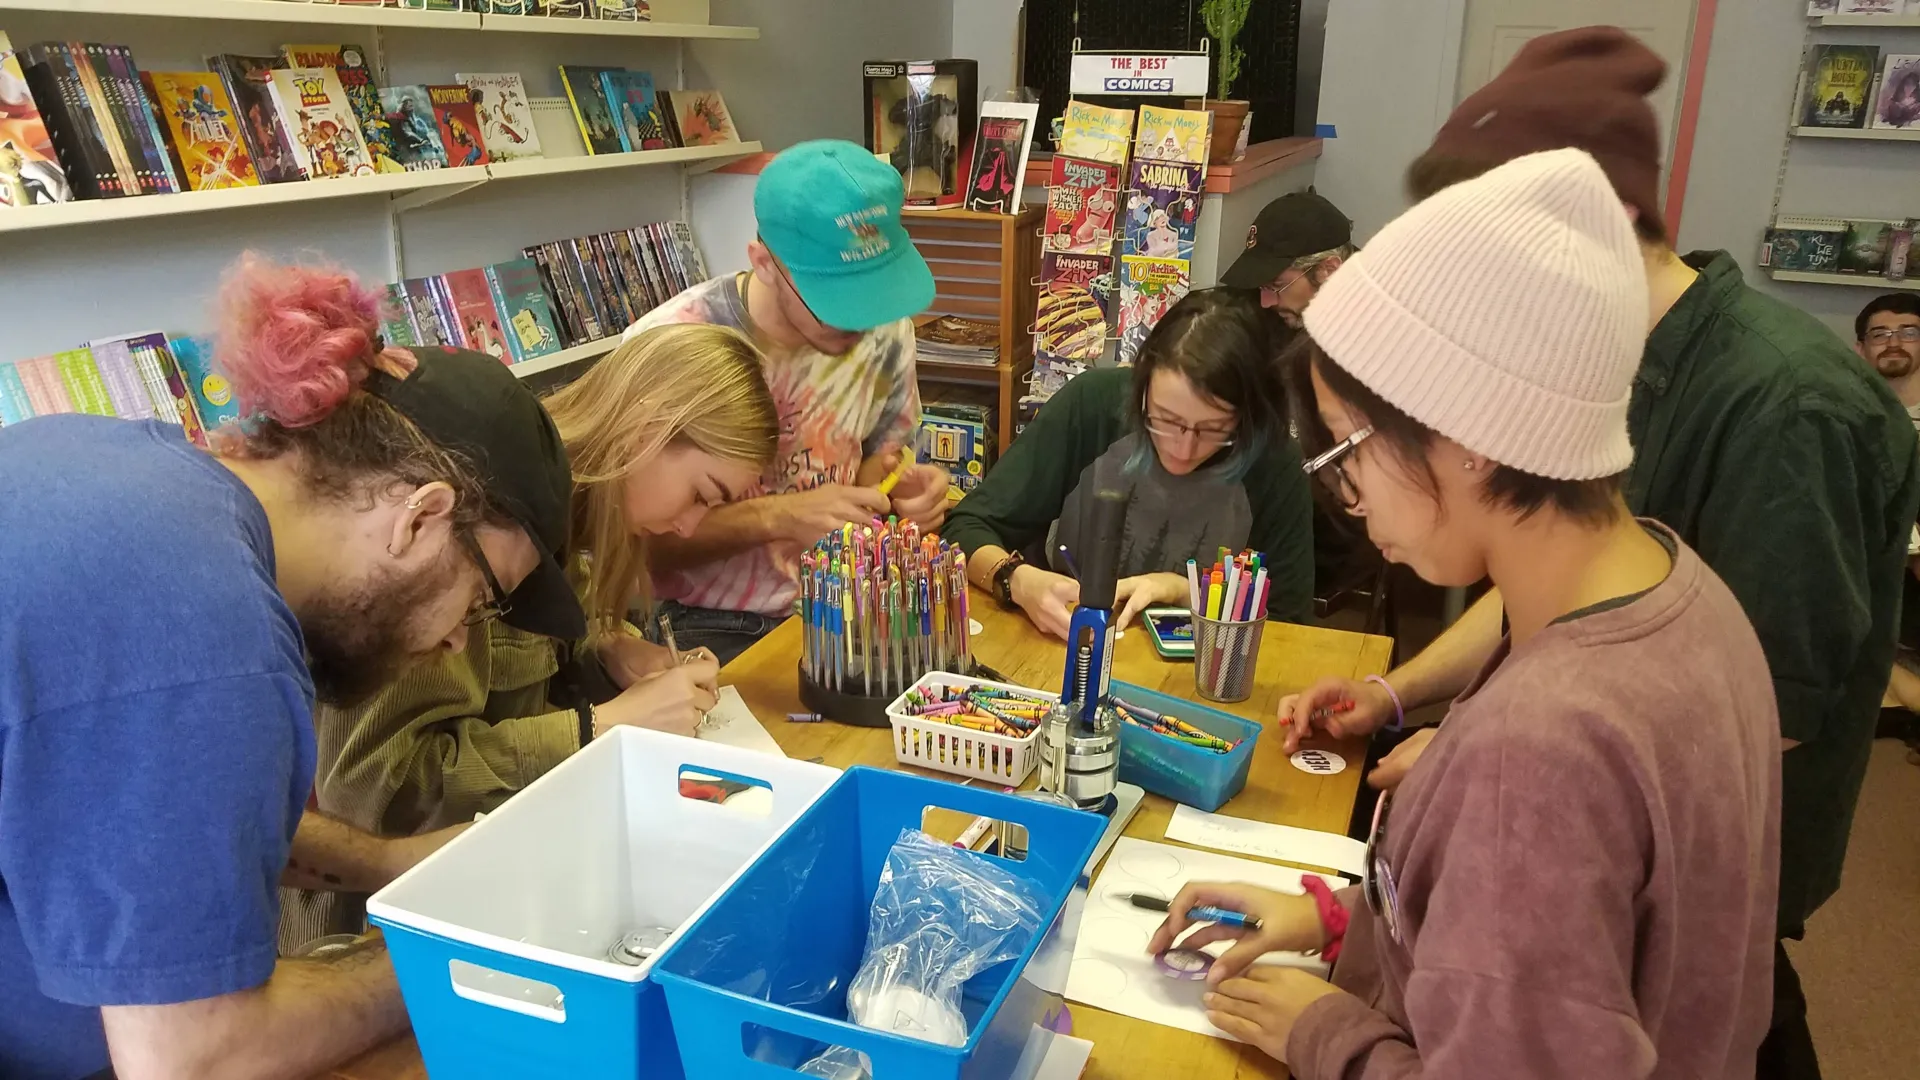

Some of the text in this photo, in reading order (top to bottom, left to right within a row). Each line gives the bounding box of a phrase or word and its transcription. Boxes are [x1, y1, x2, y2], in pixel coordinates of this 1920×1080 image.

[1110, 58, 1168, 70] THE BEST
[292, 78, 325, 96] TOY
[1106, 79, 1172, 91] COMICS
[430, 88, 470, 104] WOLVERINE
[1071, 107, 1091, 123] Rick
[1143, 110, 1163, 127] Rick
[1064, 160, 1107, 178] INVADER
[1139, 164, 1188, 187] SABRINA
[1063, 172, 1107, 188] ZIM
[1056, 255, 1099, 270] INVADER
[1150, 262, 1178, 274] Archie
[1054, 269, 1099, 283] ZIM
[1129, 263, 1148, 282] 10
[1301, 751, 1331, 771] HECK
